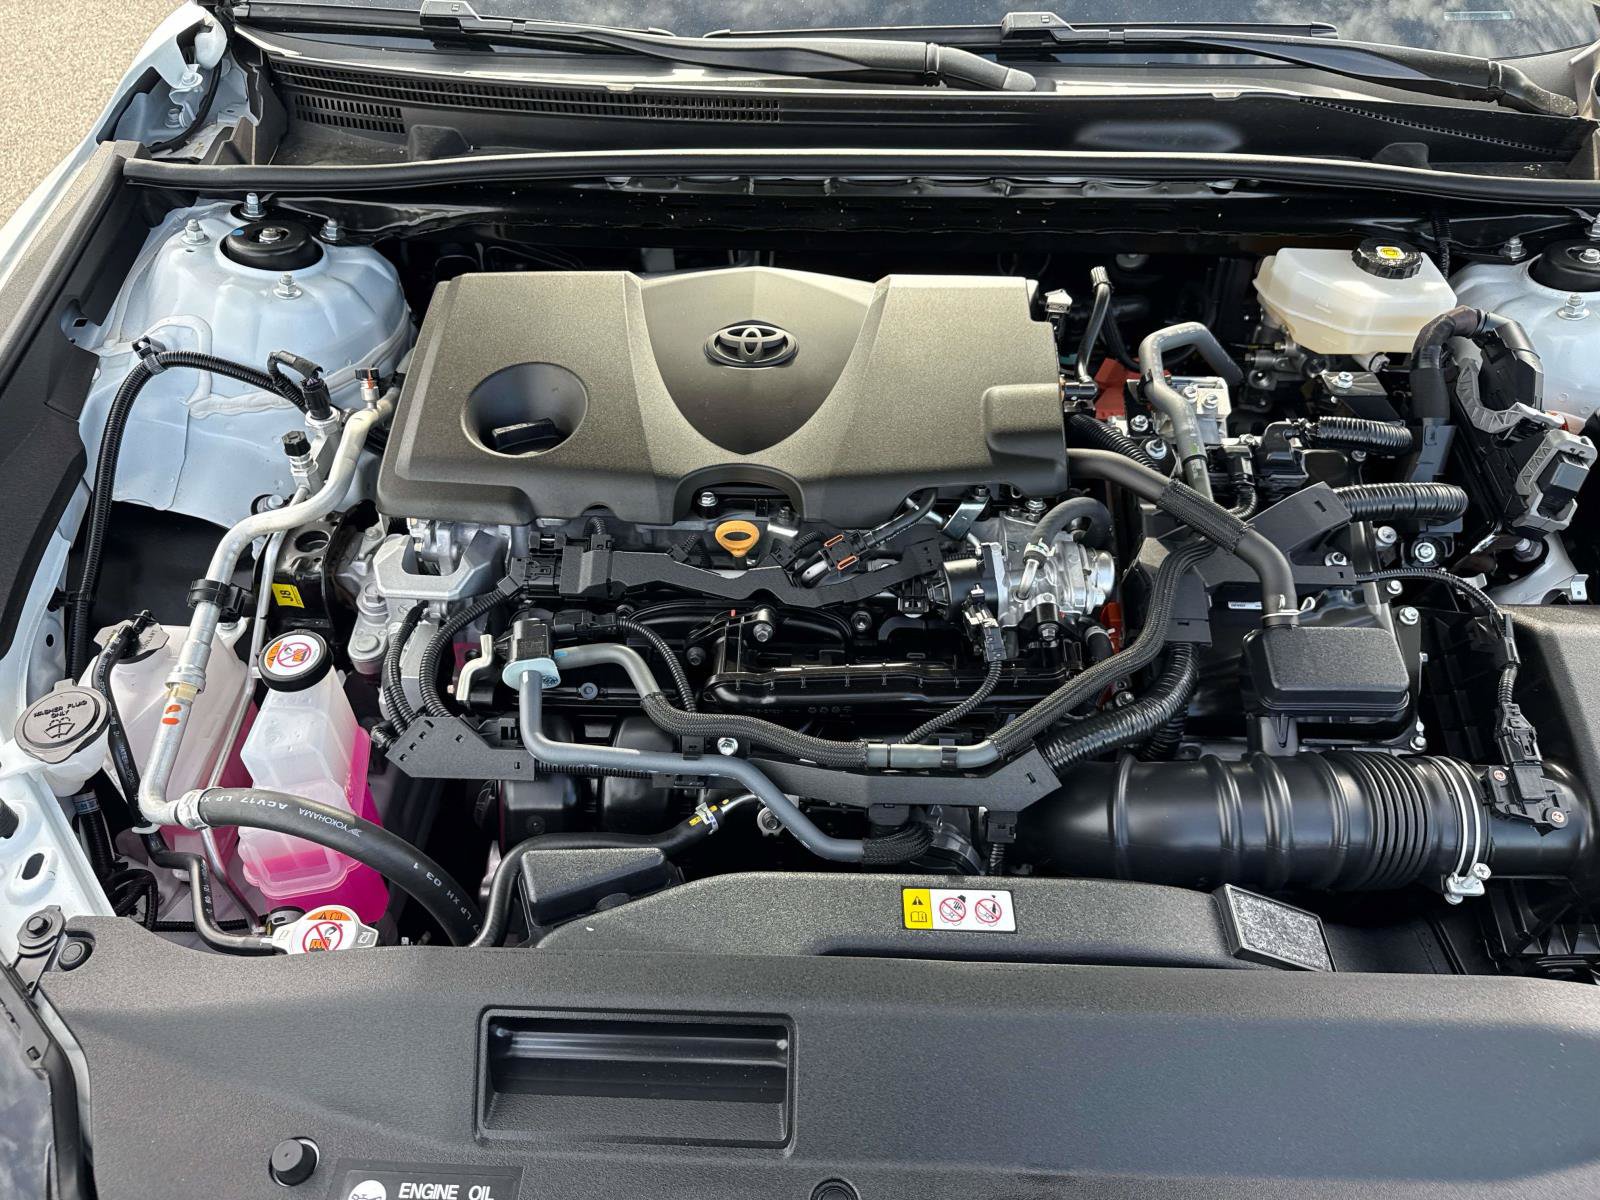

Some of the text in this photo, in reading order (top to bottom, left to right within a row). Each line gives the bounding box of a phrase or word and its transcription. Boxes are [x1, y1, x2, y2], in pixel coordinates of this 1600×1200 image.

[51, 710, 69, 719] ONLY
[240, 798, 289, 810] ACV17
[299, 808, 349, 832] YOKOHAMA
[398, 1182, 495, 1200] ENGINE OIL
